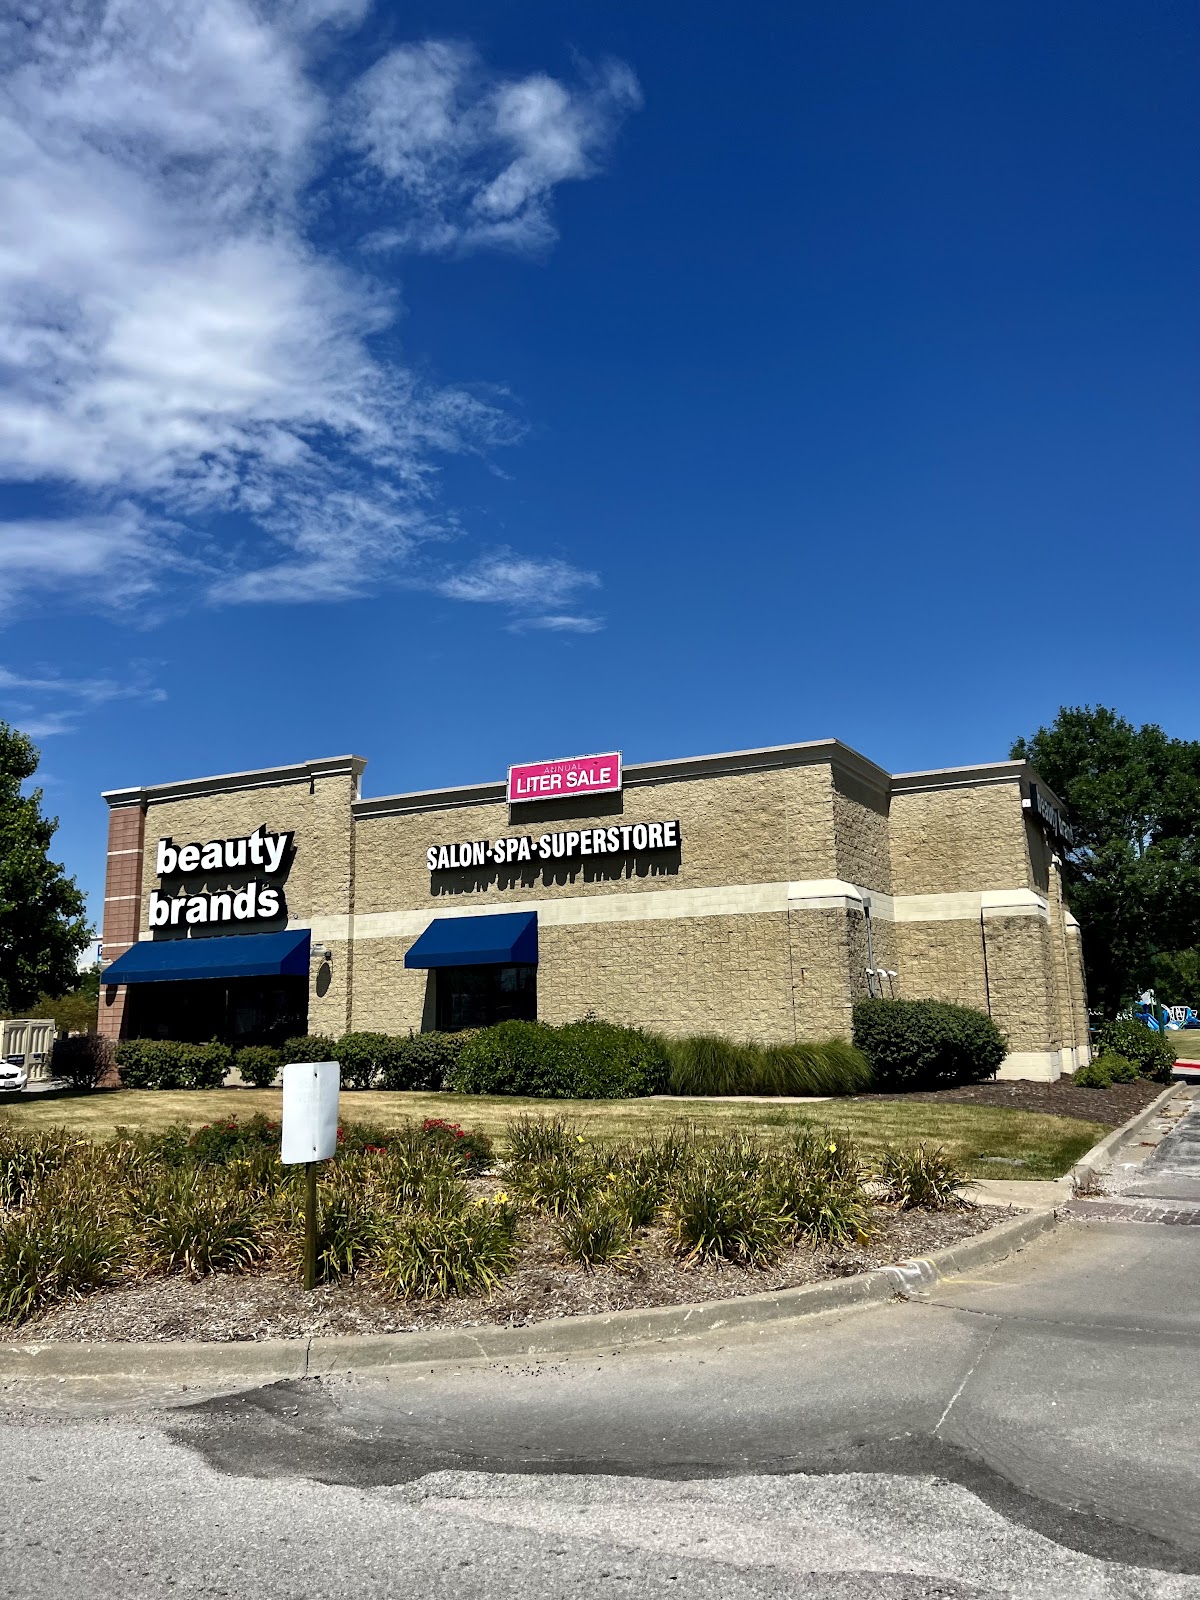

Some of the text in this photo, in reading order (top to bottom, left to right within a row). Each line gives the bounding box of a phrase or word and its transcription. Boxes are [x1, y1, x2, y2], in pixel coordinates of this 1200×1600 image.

[516, 767, 611, 794] LITER SALE
[543, 763, 583, 774] ANNUAL
[156, 829, 288, 874] beauty
[148, 882, 280, 926] brands
